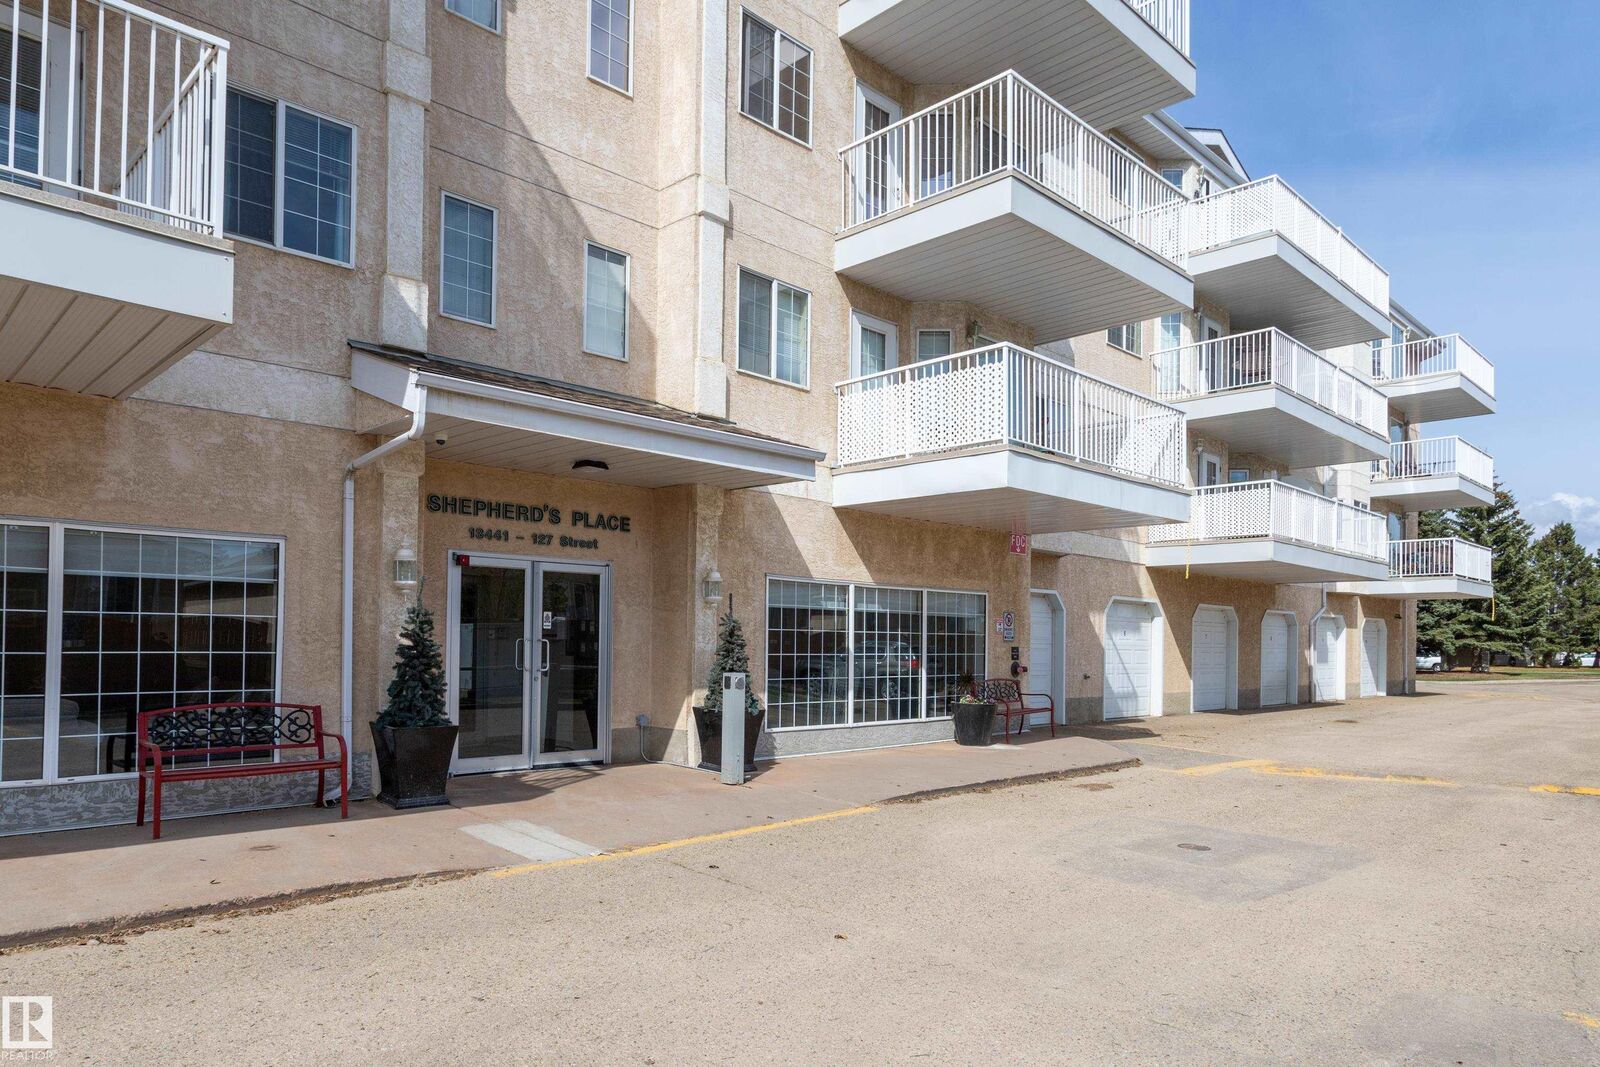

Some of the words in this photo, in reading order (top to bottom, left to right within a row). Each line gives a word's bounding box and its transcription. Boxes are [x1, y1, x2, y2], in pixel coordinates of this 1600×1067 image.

[427, 494, 561, 525] SHEPHERD'S
[571, 510, 631, 532] PLACE
[468, 527, 509, 542] 13441
[531, 532, 554, 546] 127
[559, 535, 599, 550] Street
[1011, 534, 1026, 547] FDC
